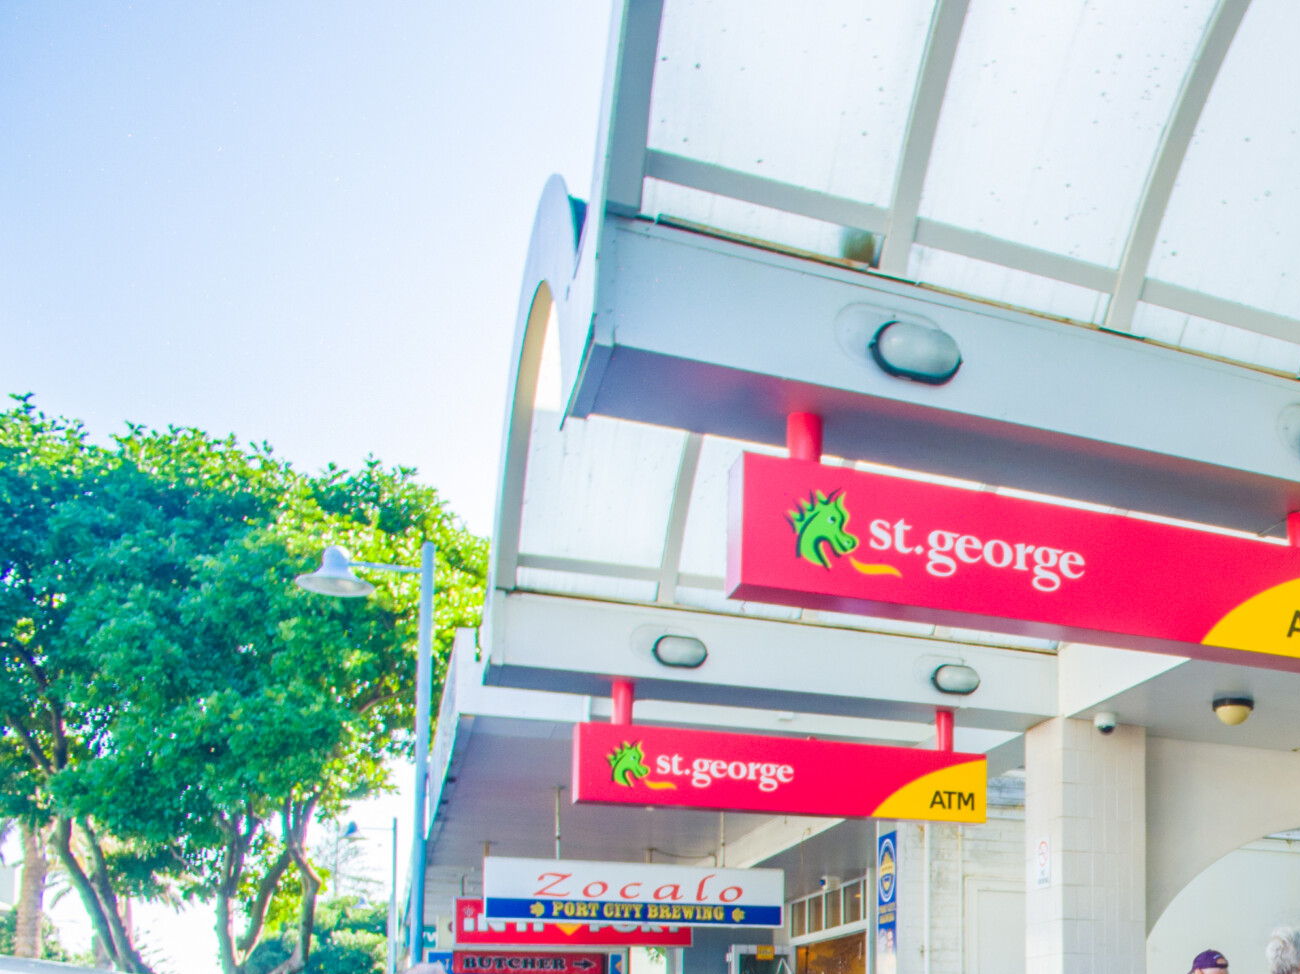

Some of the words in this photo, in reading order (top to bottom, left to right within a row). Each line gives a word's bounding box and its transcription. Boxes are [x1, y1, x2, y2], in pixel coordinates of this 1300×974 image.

[869, 518, 1085, 592] st.george
[656, 753, 794, 792] st.george
[929, 790, 975, 811] ATM
[533, 872, 743, 903] Zocalo
[552, 901, 599, 917] PORT
[603, 902, 643, 919] CITY
[647, 904, 725, 921] BREWING
[463, 956, 567, 970] BUTCHER
